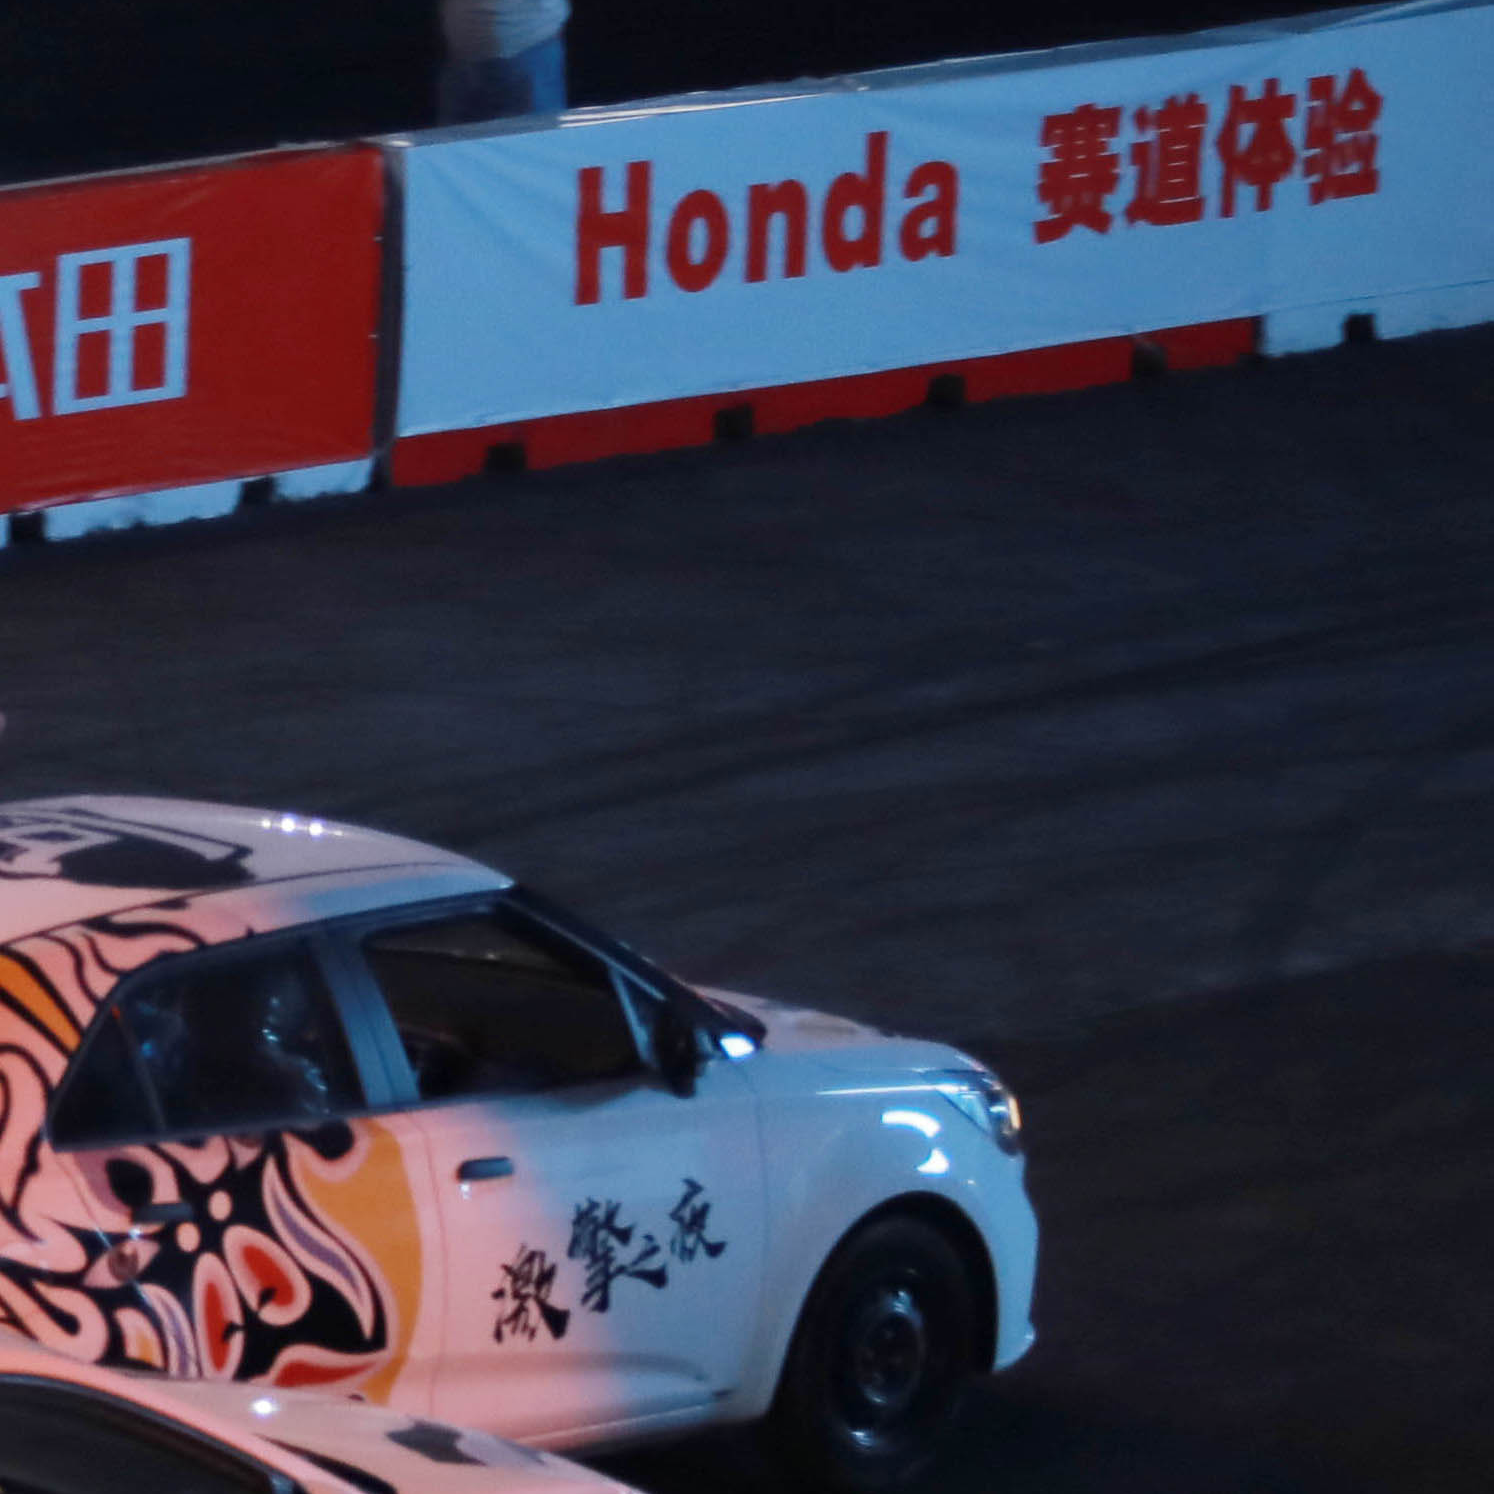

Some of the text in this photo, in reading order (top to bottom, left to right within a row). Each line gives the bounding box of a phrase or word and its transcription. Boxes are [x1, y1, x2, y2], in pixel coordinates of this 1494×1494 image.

[574, 68, 1384, 304] Honda 赛道体验
